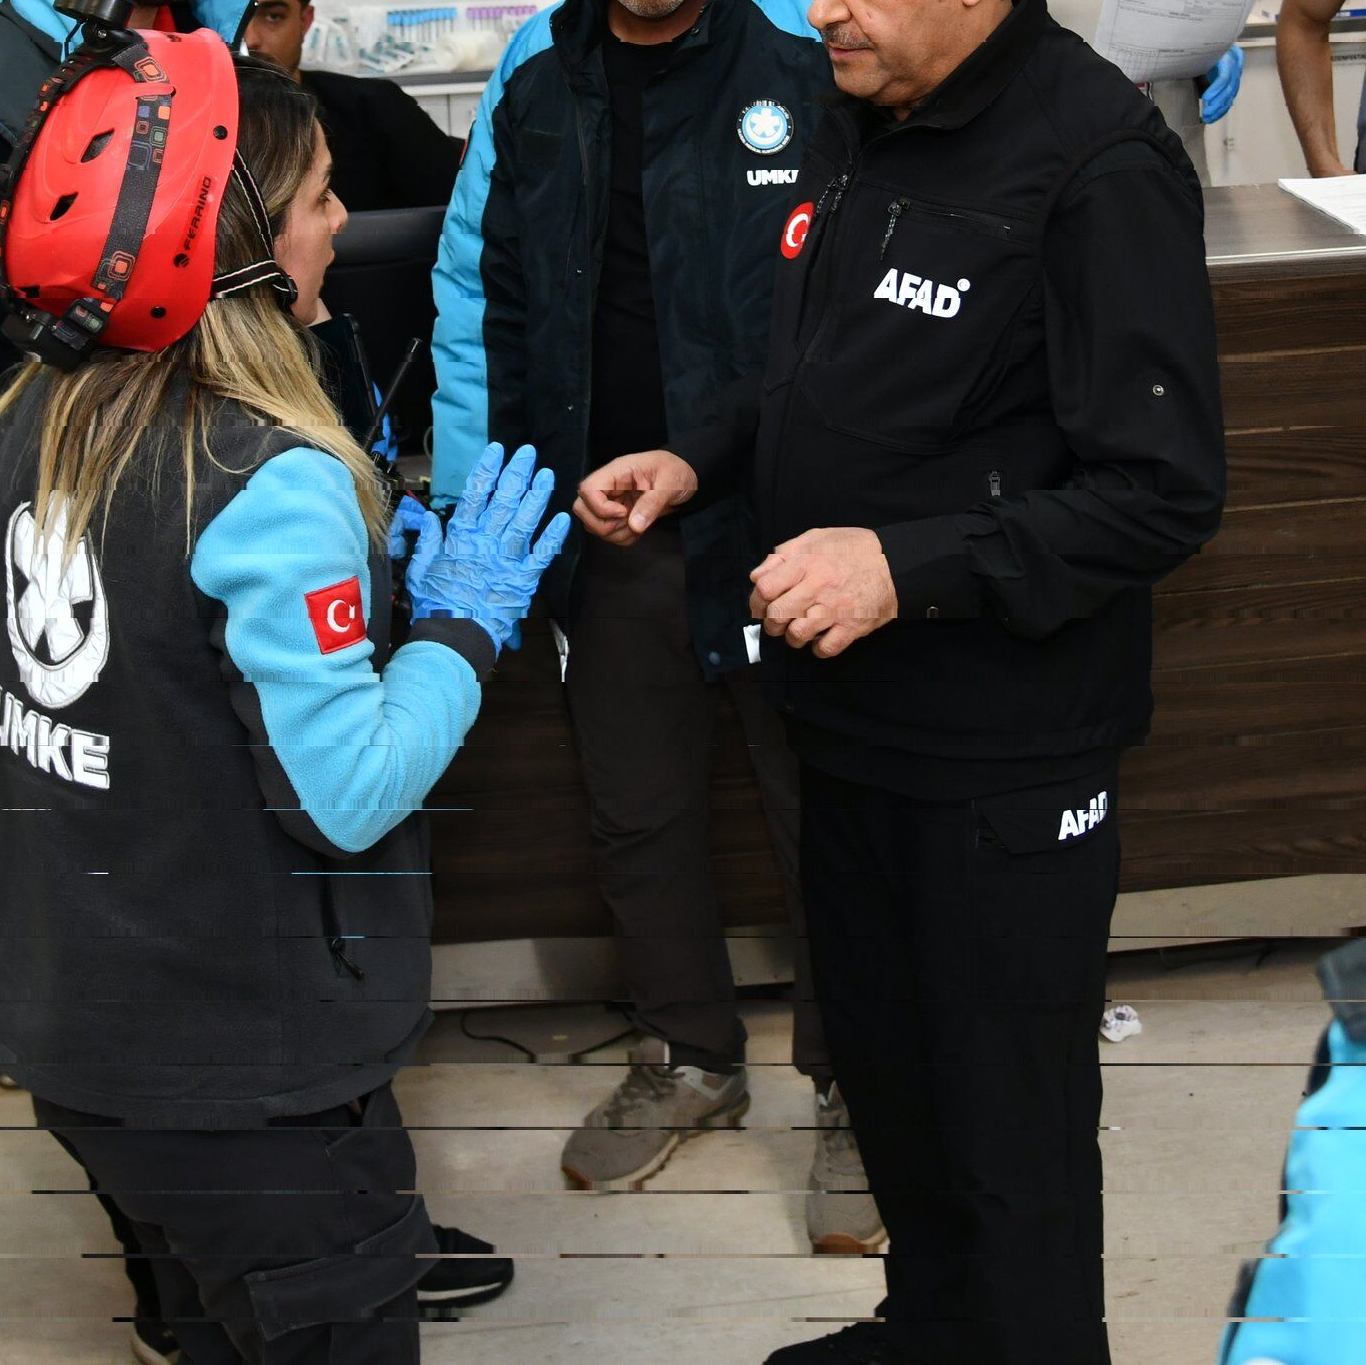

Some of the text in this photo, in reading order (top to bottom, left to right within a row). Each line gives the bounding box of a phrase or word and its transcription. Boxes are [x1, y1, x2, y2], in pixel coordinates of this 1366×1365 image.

[183, 176, 212, 251] FERRINO
[873, 267, 962, 319] AFAD
[1057, 790, 1108, 841] AFAD
